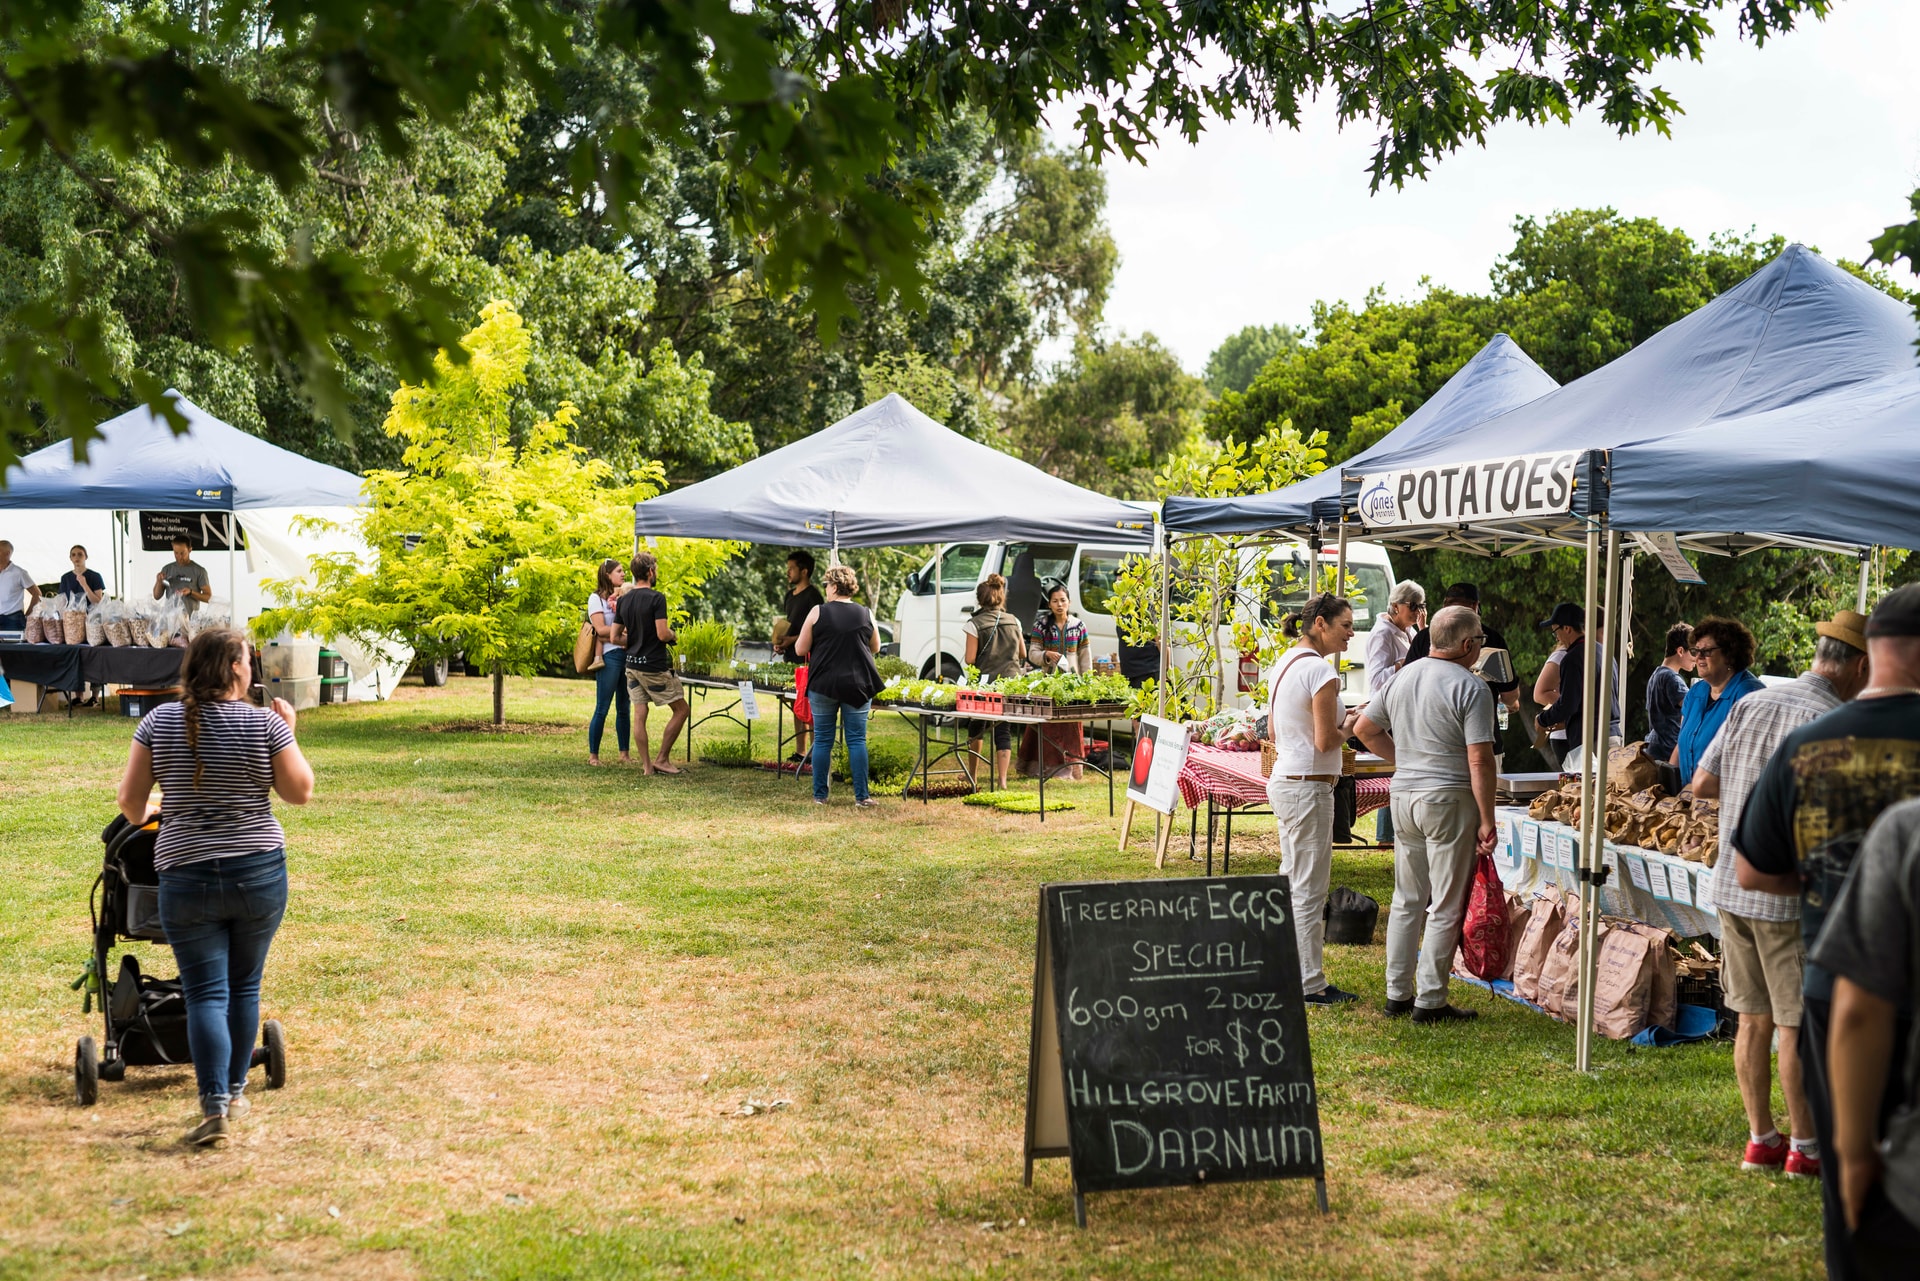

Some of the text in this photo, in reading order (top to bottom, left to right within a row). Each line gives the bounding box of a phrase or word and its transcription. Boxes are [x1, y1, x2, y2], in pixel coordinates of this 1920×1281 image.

[1398, 454, 1574, 521] POTATOES
[1370, 489, 1394, 519] Jones
[1375, 510, 1396, 518] POTATOES
[152, 516, 181, 524] wholefoods
[167, 525, 189, 534] delivery
[151, 533, 163, 541] bulk
[1058, 884, 1286, 932] FREERANGE EGGS
[1132, 940, 1264, 973] SPECIAL
[1205, 987, 1226, 1010] 2
[1232, 992, 1283, 1012] DOZ
[1185, 1017, 1286, 1068] FOR $8
[1067, 1068, 1312, 1108] HILLGROVE FARM
[1110, 1119, 1317, 1175] DARNUM
